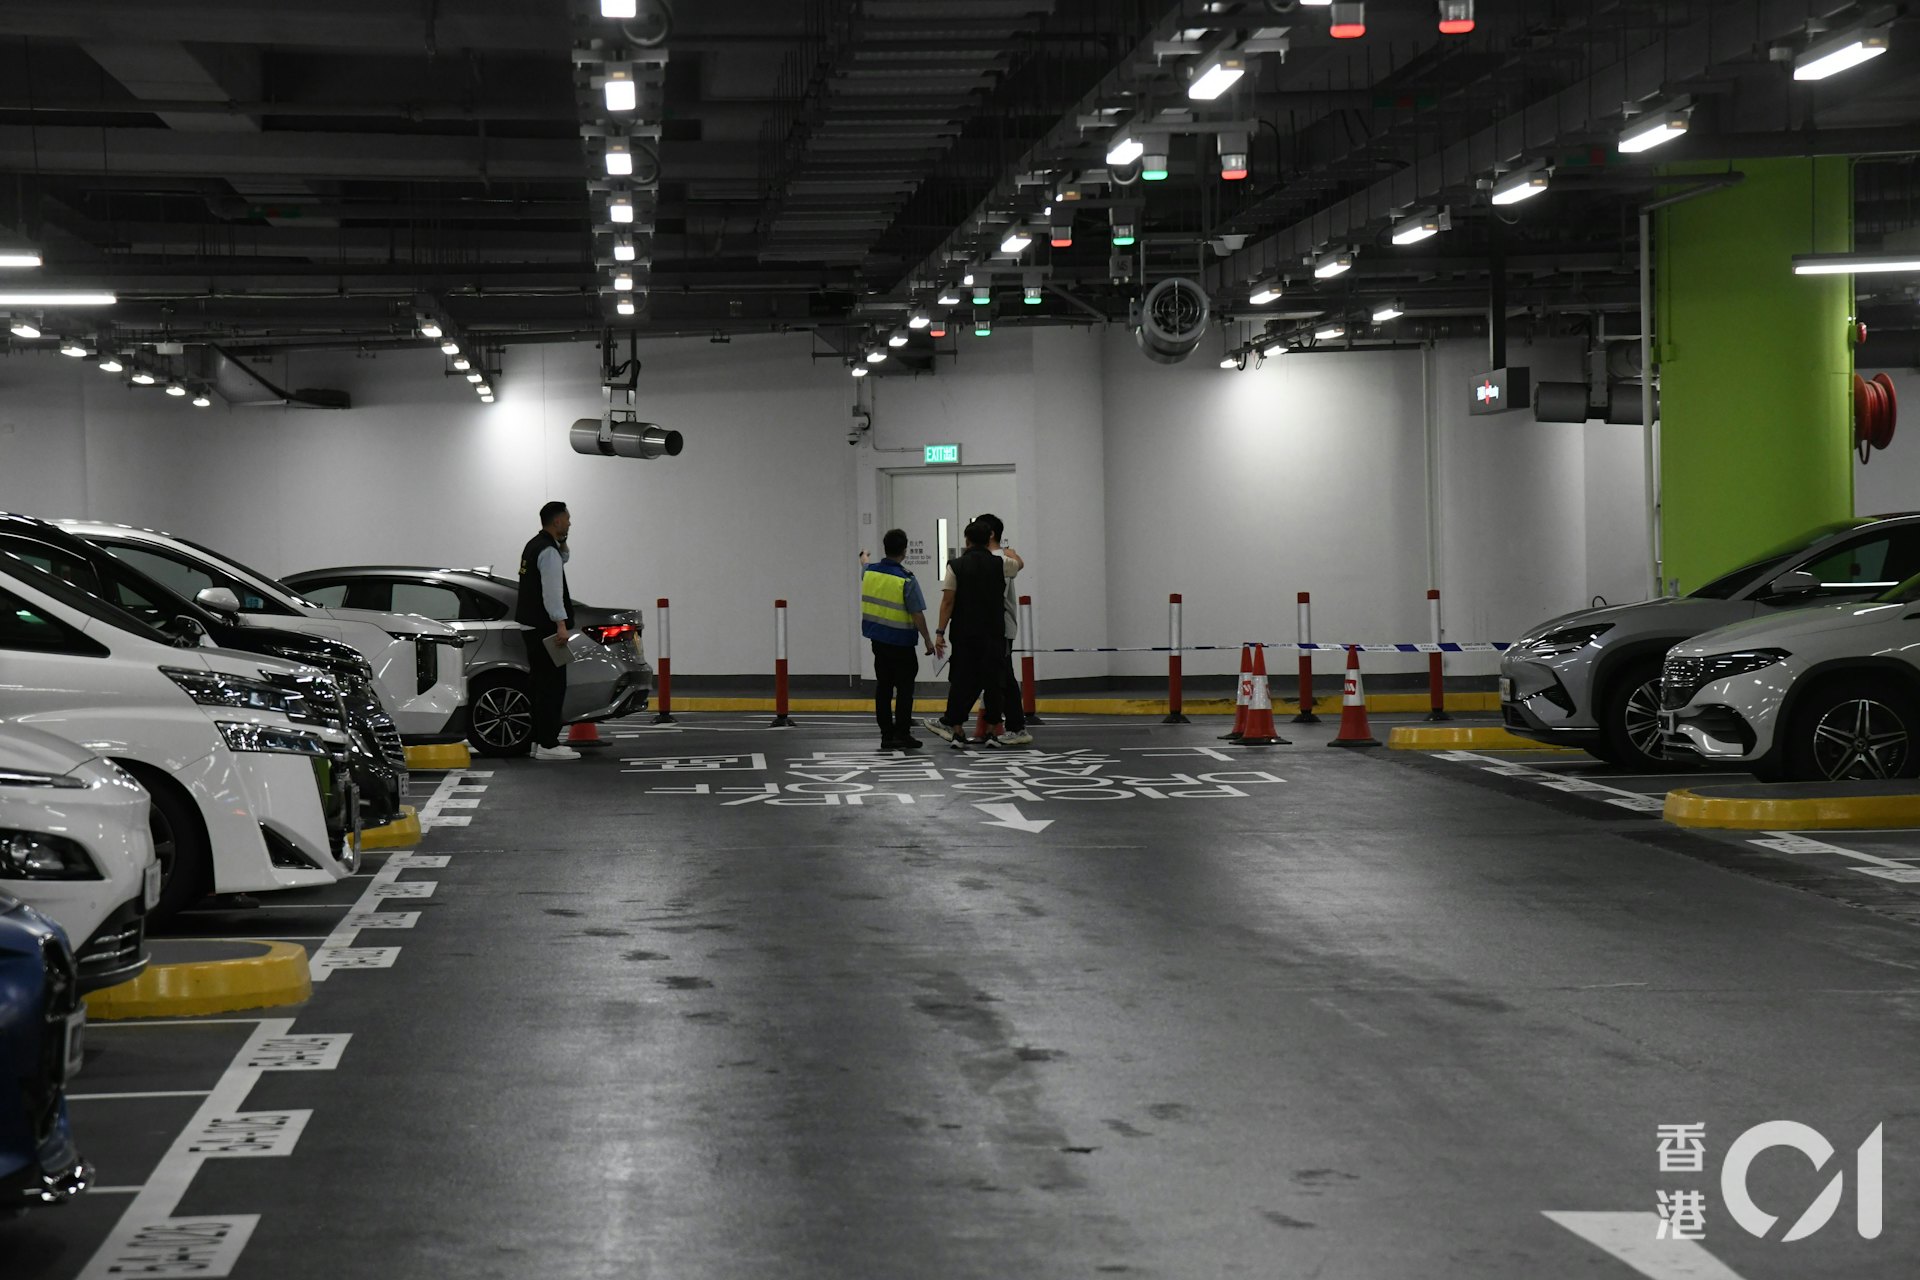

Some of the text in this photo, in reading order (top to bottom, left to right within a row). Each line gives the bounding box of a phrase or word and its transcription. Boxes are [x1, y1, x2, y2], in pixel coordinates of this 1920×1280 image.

[926, 446, 943, 462] EXIT
[644, 771, 1287, 794] DROP OFF
[785, 764, 1104, 782] AREA
[719, 784, 1250, 806] PICK-UP/
[248, 1037, 335, 1068] 5A-024
[188, 1114, 291, 1153] 5A-025
[107, 1221, 234, 1273] 5A-026
